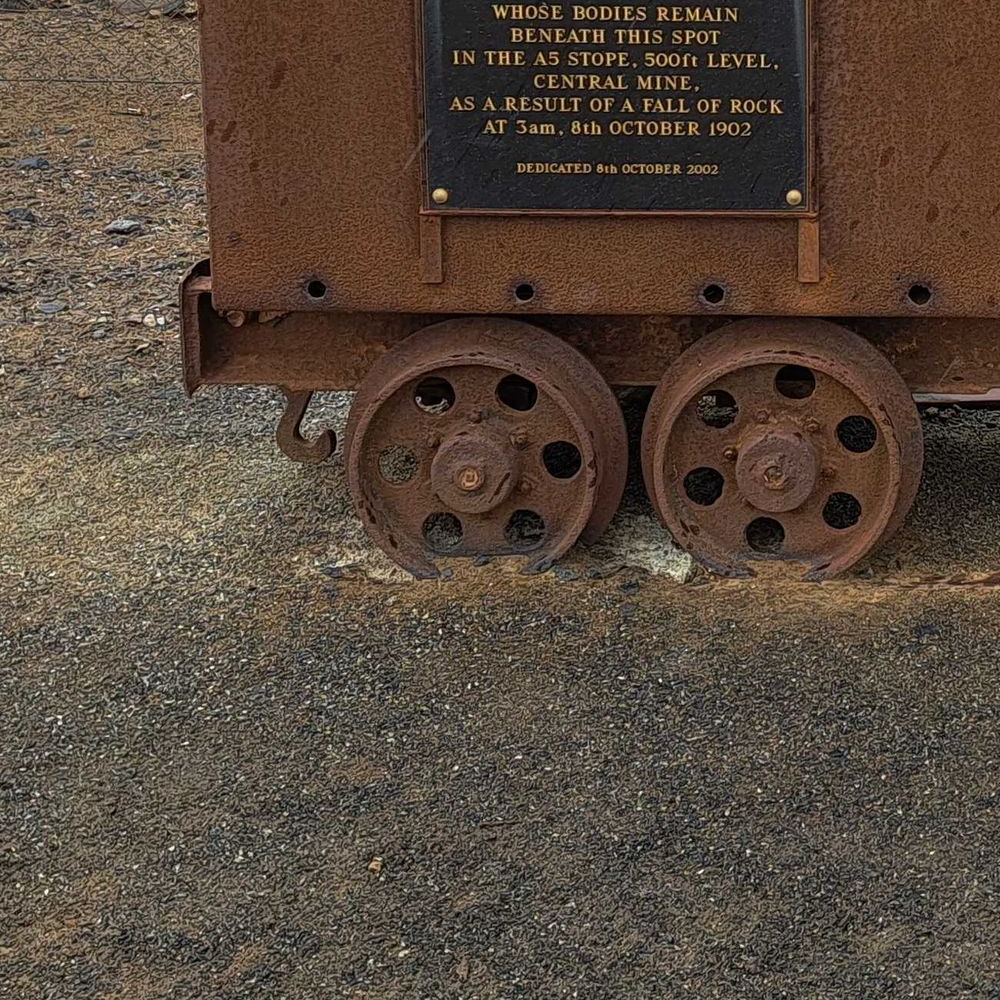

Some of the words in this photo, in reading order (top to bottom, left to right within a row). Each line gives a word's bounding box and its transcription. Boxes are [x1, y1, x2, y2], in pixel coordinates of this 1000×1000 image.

[491, 5, 563, 21] WHOSE
[572, 6, 647, 22] BODIES
[656, 7, 739, 23] REMAIN
[511, 29, 605, 45] BENEATH
[614, 30, 663, 45] THIS
[671, 30, 721, 46] SPOT
[452, 51, 476, 67] IN
[484, 51, 526, 67] THE
[533, 51, 560, 68] A5
[567, 52, 638, 69] STOPE,
[643, 53, 698, 69] 500ft
[707, 53, 780, 71] LEVEL,
[533, 75, 629, 91] CENTRAL
[636, 76, 700, 92] MINE,
[449, 97, 475, 113] AS
[482, 97, 498, 113] A
[504, 97, 582, 113] RESULT
[589, 98, 614, 114] OF
[619, 98, 635, 114] A
[643, 98, 691, 114] FALL
[697, 99, 722, 114] OF
[730, 99, 784, 115] ROCK
[482, 120, 508, 135] AT
[515, 120, 564, 137] 3am,
[571, 121, 601, 136] 8th
[609, 121, 701, 137] OCTOBER
[709, 122, 752, 138] 1902
[516, 163, 592, 174] DEDICATED
[596, 163, 618, 174] 8th
[622, 164, 682, 175] OCTOBER
[686, 164, 719, 175] 2002
